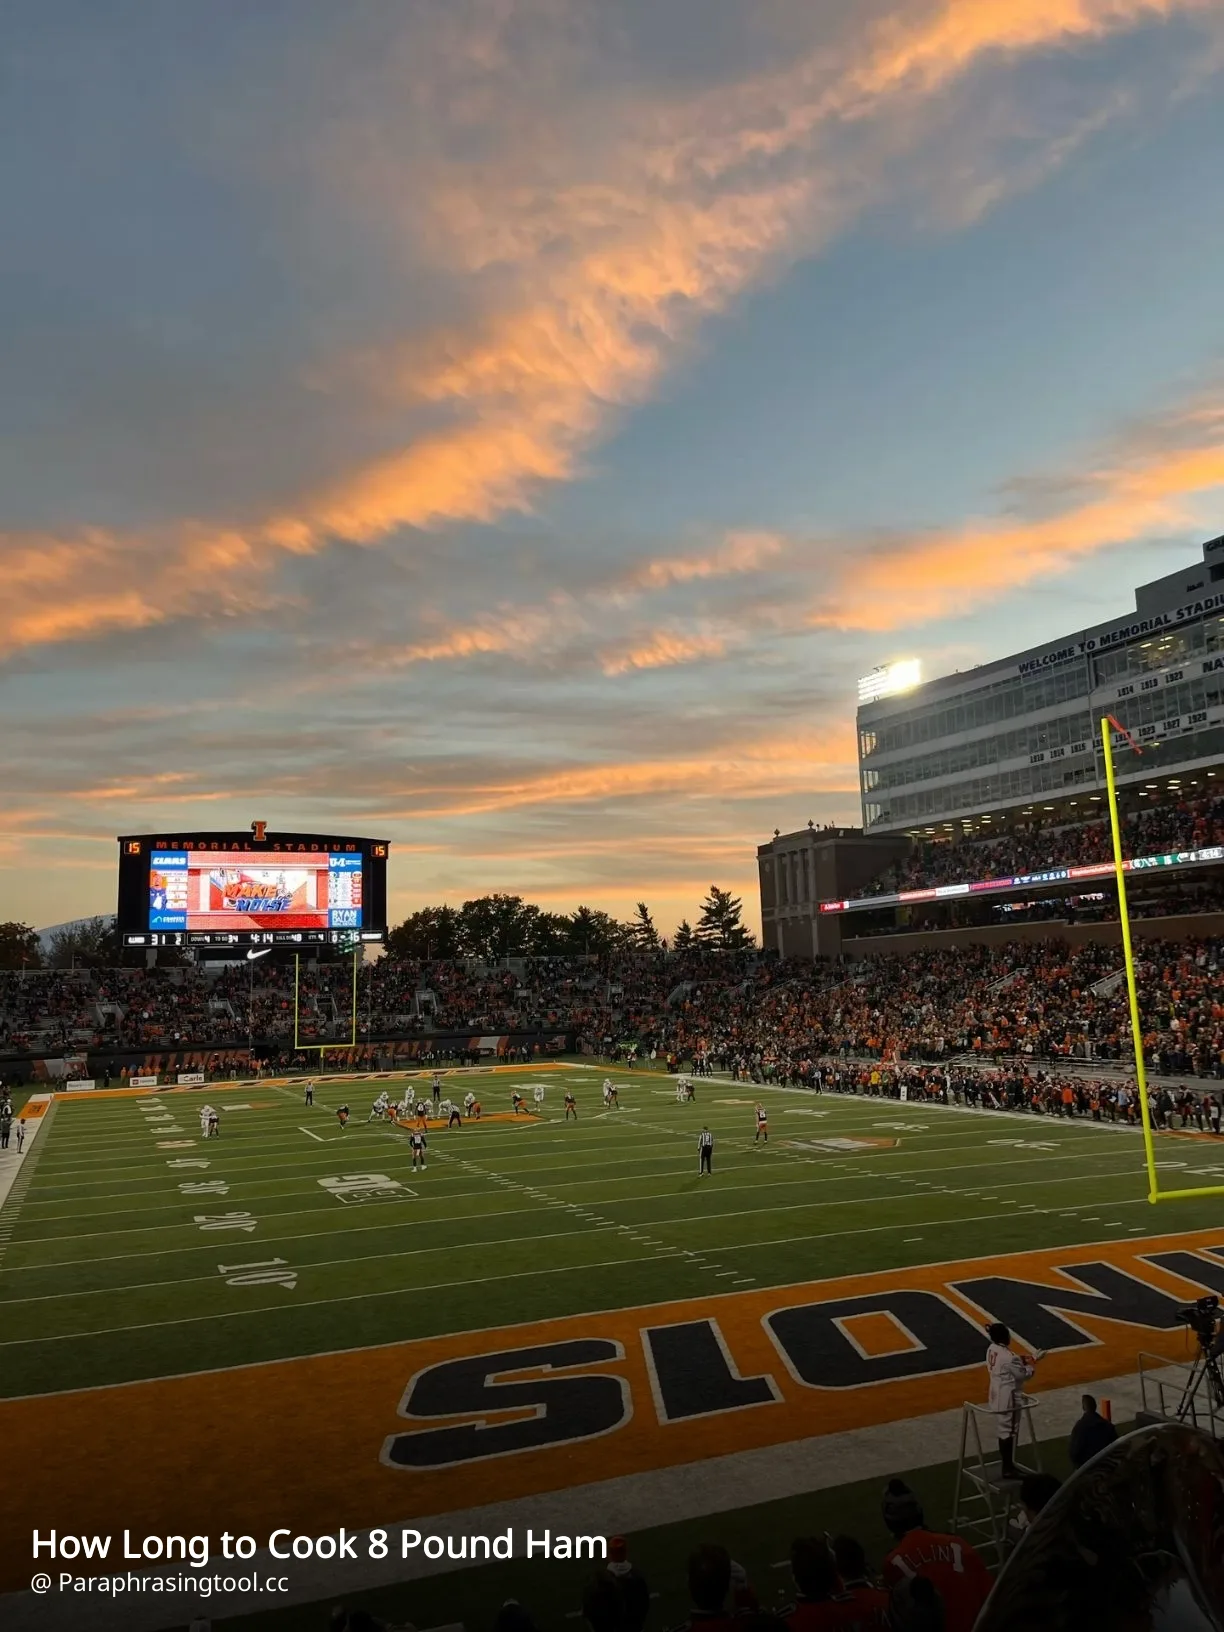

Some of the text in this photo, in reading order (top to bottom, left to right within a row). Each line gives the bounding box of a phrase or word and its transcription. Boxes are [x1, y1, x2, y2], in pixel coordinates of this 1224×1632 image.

[1018, 646, 1075, 673] WELCOME
[1078, 640, 1096, 653] TO
[1100, 614, 1172, 646] MEMORIAL
[1117, 685, 1134, 697] 1914
[1163, 718, 1180, 731] 1927
[128, 842, 140, 854] 15
[156, 841, 356, 852] MEMORIAL STADIUM
[375, 845, 385, 856] 15
[222, 883, 277, 898] MAKE
[236, 897, 291, 912] NOISE
[204, 935, 210, 943] 4
[250, 934, 274, 944] 4:14
[184, 1074, 202, 1082] Carle
[178, 1180, 230, 1194] 30
[194, 1211, 260, 1232] 20
[218, 1257, 298, 1287] 10
